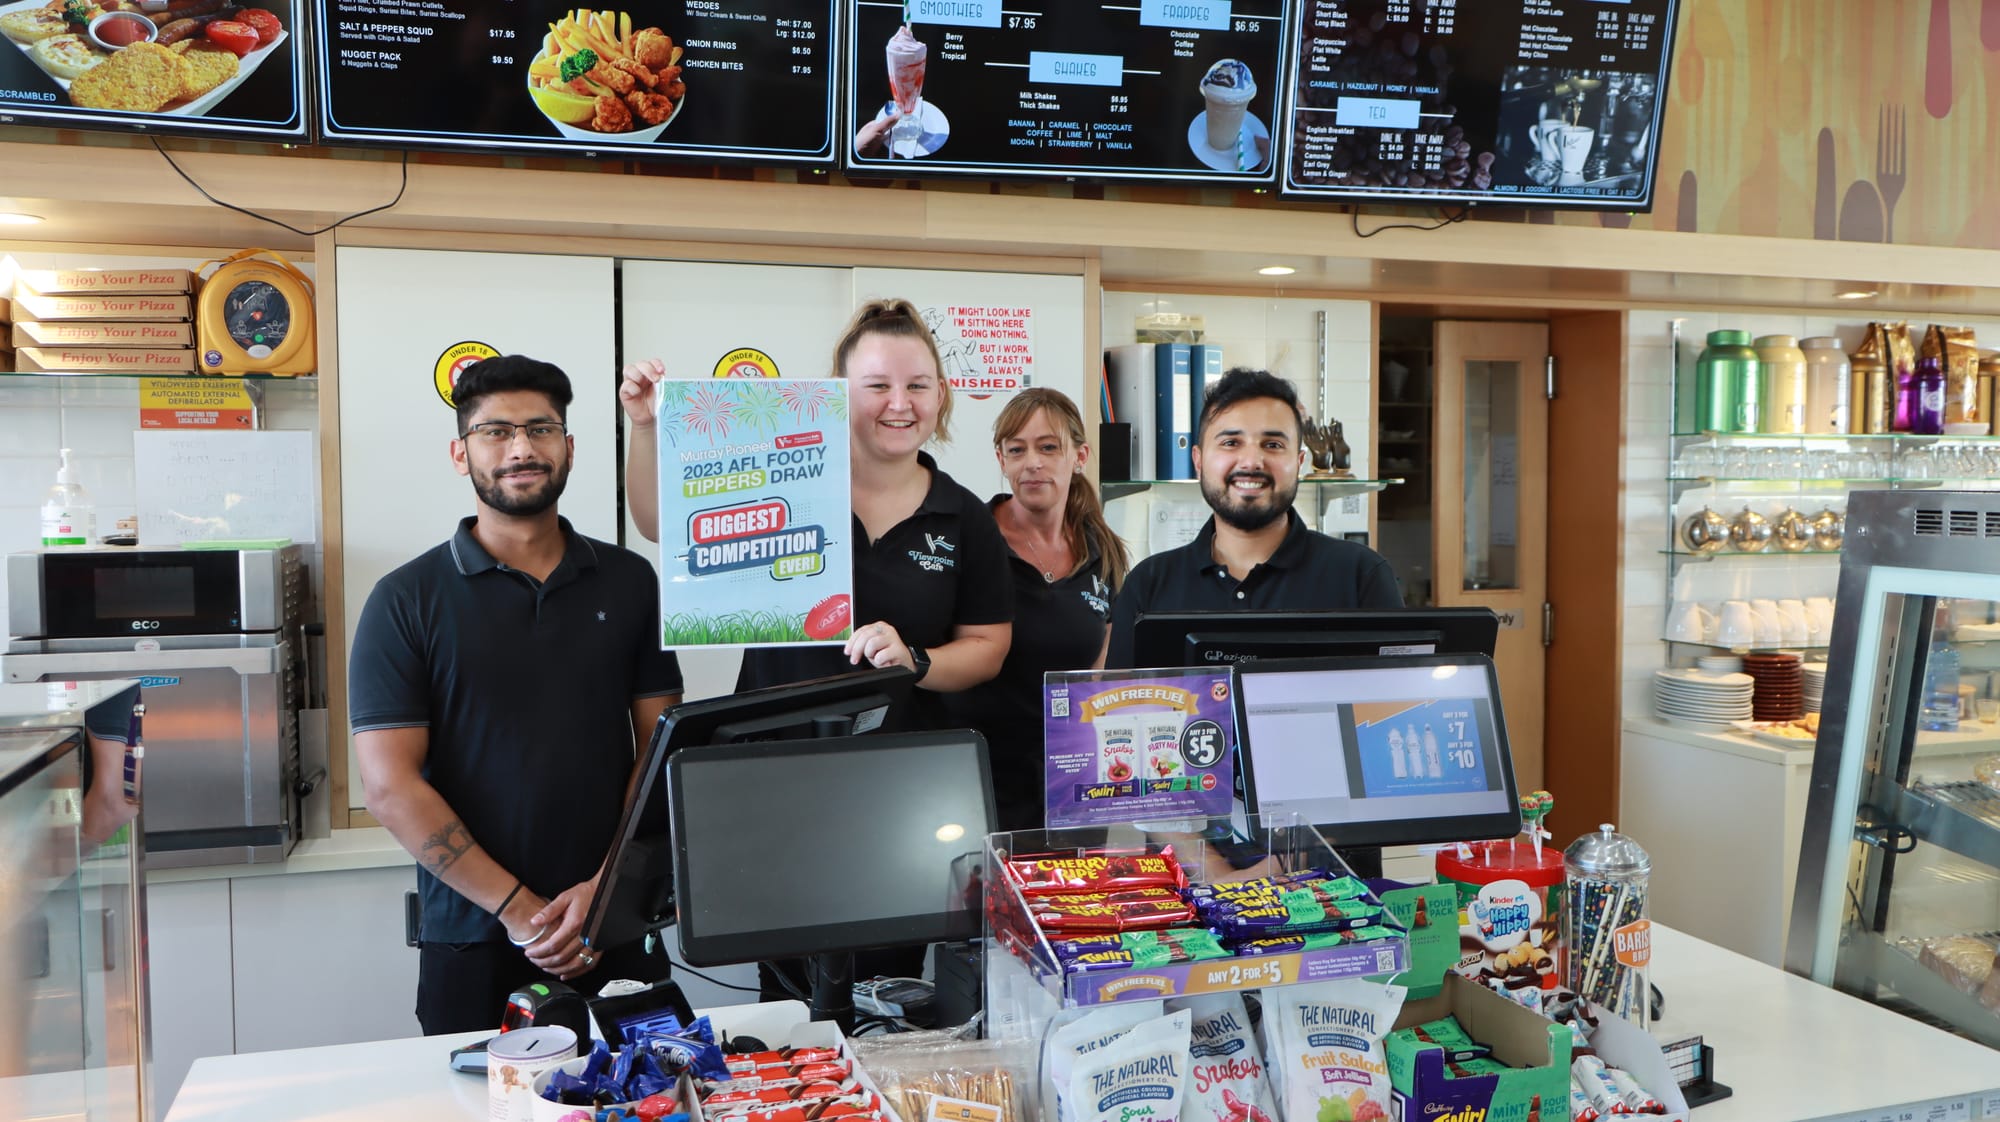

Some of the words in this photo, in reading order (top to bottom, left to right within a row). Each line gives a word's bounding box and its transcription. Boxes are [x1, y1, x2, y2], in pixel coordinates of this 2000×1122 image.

[686, 0, 720, 10] WEDGES
[920, 1, 983, 18] SMOOTHIES
[1316, 1, 1338, 9] Piccolo
[1163, 4, 1210, 21] FRAPPES
[1315, 10, 1331, 18] Short
[1332, 11, 1348, 19] Black
[793, 20, 812, 29] $7.00
[1008, 17, 1036, 29] $7.95
[1235, 21, 1260, 32] $6.95
[1315, 20, 1329, 28] Long
[1330, 20, 1346, 28] Black
[340, 22, 360, 31] SALT
[371, 25, 404, 34] PEPPER
[407, 27, 434, 36] SQUID
[489, 29, 515, 39] $17.95
[1170, 30, 1200, 39] Chocolate
[1532, 25, 1558, 33] Chocolate
[377, 34, 395, 42] Chips
[792, 30, 816, 40] $12.00
[945, 32, 963, 42] Berry
[1547, 34, 1573, 43] Chocolate
[686, 39, 711, 48] ONION
[712, 40, 737, 50] RINGS
[944, 43, 964, 51] Green
[1175, 40, 1194, 48] Coffee
[1313, 38, 1346, 46] Cappuccino
[1542, 43, 1568, 51] Chocolate
[341, 50, 376, 60] NUGGET
[379, 51, 401, 61] PACK
[941, 52, 967, 61] Tropical
[1174, 49, 1194, 57] Mocha
[347, 60, 372, 69] Nuggets
[380, 61, 398, 70] Chips
[492, 55, 514, 65] $9.50
[686, 59, 720, 69] CHICKEN
[721, 61, 744, 71] BITES
[1054, 61, 1097, 77] SHAKES
[1310, 81, 1339, 89] CARAMEL
[1347, 82, 1378, 91] HAZELNUT
[1415, 86, 1439, 94] VANILLA
[1019, 91, 1032, 100] Milk
[1034, 92, 1057, 101] Shakes
[1020, 101, 1036, 110] Thick
[1038, 102, 1060, 110] Shakes
[1369, 106, 1386, 119] TEA
[1008, 120, 1036, 128] BANANA
[1048, 121, 1080, 130] CARAMEL
[1093, 123, 1133, 132] CHOCOLATE
[1306, 126, 1327, 134] English
[1328, 126, 1355, 135] Breakfast
[1026, 130, 1053, 138] COFFEE
[1066, 131, 1083, 139] LIME
[1095, 132, 1112, 140] MALT
[1305, 135, 1338, 144] Peppermint
[1010, 138, 1035, 146] MOCHA
[1048, 140, 1093, 149] STRAWBERRY
[1106, 142, 1133, 150] VANILLA
[1305, 144, 1323, 152] Green
[1304, 152, 1332, 160] Camomile
[1303, 169, 1322, 177] Lemon
[1328, 170, 1347, 179] Ginger
[57, 274, 96, 286] Enjoy
[101, 274, 134, 285] Your
[138, 273, 175, 284] Pizza
[56, 301, 96, 313] Enjoy
[101, 300, 134, 311] Your
[138, 300, 175, 311] Pizza
[948, 307, 955, 315] IT
[958, 307, 984, 316] MIGHT
[987, 308, 1010, 317] LOOK
[1012, 308, 1031, 317] LIKE
[953, 318, 965, 327] I'M
[967, 318, 1000, 328] SITTING
[1002, 319, 1024, 328] HERE
[57, 327, 98, 339] Enjoy
[104, 327, 136, 337] Your
[141, 327, 177, 337] Pizza
[961, 329, 988, 338] DOING
[990, 330, 1029, 340] NOTHING,
[450, 346, 476, 359] UNDER
[479, 347, 488, 355] 18
[979, 344, 996, 353] BUT
[1004, 345, 1028, 353] WORK
[61, 352, 102, 365] Enjoy
[107, 353, 140, 363] Your
[145, 353, 181, 364] Pizza
[729, 352, 753, 363] UNDER
[755, 354, 763, 362] 18
[983, 355, 994, 364] SO
[997, 355, 1018, 364] FAST
[1021, 356, 1032, 364] I'M
[988, 366, 1023, 375] ALWAYS
[680, 448, 723, 464] Murray
[725, 441, 772, 456] Pioneer
[683, 461, 723, 481] 2023
[728, 456, 761, 474] AFL
[767, 445, 827, 468] FOOTY
[685, 471, 762, 497] TIPPERS
[770, 463, 824, 484] DRAW
[700, 506, 780, 539] BIGGEST
[696, 529, 818, 568] COMPETITION
[908, 550, 955, 567] Viewpoint
[779, 555, 815, 576] EVER!
[919, 560, 944, 572] Cafe
[132, 619, 160, 630] eco
[1091, 692, 1119, 710] WIN
[1121, 688, 1153, 699] FREE
[1154, 689, 1186, 705] FUEL
[1449, 722, 1465, 740] $7
[1189, 735, 1215, 764] $5
[1449, 750, 1475, 769] $10
[1087, 784, 1115, 799] Twirl
[1037, 857, 1109, 871] CHERRY
[1136, 858, 1165, 867] TWIN
[1140, 865, 1169, 873] PACK
[1429, 898, 1453, 907] FOUR
[1237, 906, 1289, 919] Twirl
[1430, 907, 1454, 917] PACK
[1489, 903, 1529, 923] Happy
[1493, 919, 1530, 937] Hippo
[1077, 950, 1133, 963] Twirl
[1208, 971, 1227, 984] ANY
[1230, 965, 1242, 985] 2
[1243, 967, 1261, 980] FOR
[1263, 960, 1282, 983] $5
[1106, 980, 1123, 993] WIN
[1124, 978, 1145, 986] FREE
[1145, 979, 1166, 988] FUEL
[1299, 1005, 1319, 1027] THE
[1322, 1006, 1377, 1035] NATURAL
[1308, 1027, 1354, 1036] CONFECTIONERY
[1301, 1051, 1337, 1070] Fruit
[1341, 1052, 1387, 1075] Salad
[1092, 1068, 1116, 1095] THE
[1118, 1054, 1178, 1083] NATURAL
[1193, 1056, 1262, 1093] Snakes
[1324, 1070, 1343, 1081] Soft
[1344, 1070, 1370, 1083] Jellies
[1544, 1096, 1566, 1107] FOUR
[1120, 1105, 1155, 1122] Sour
[1544, 1106, 1566, 1116] PACK
